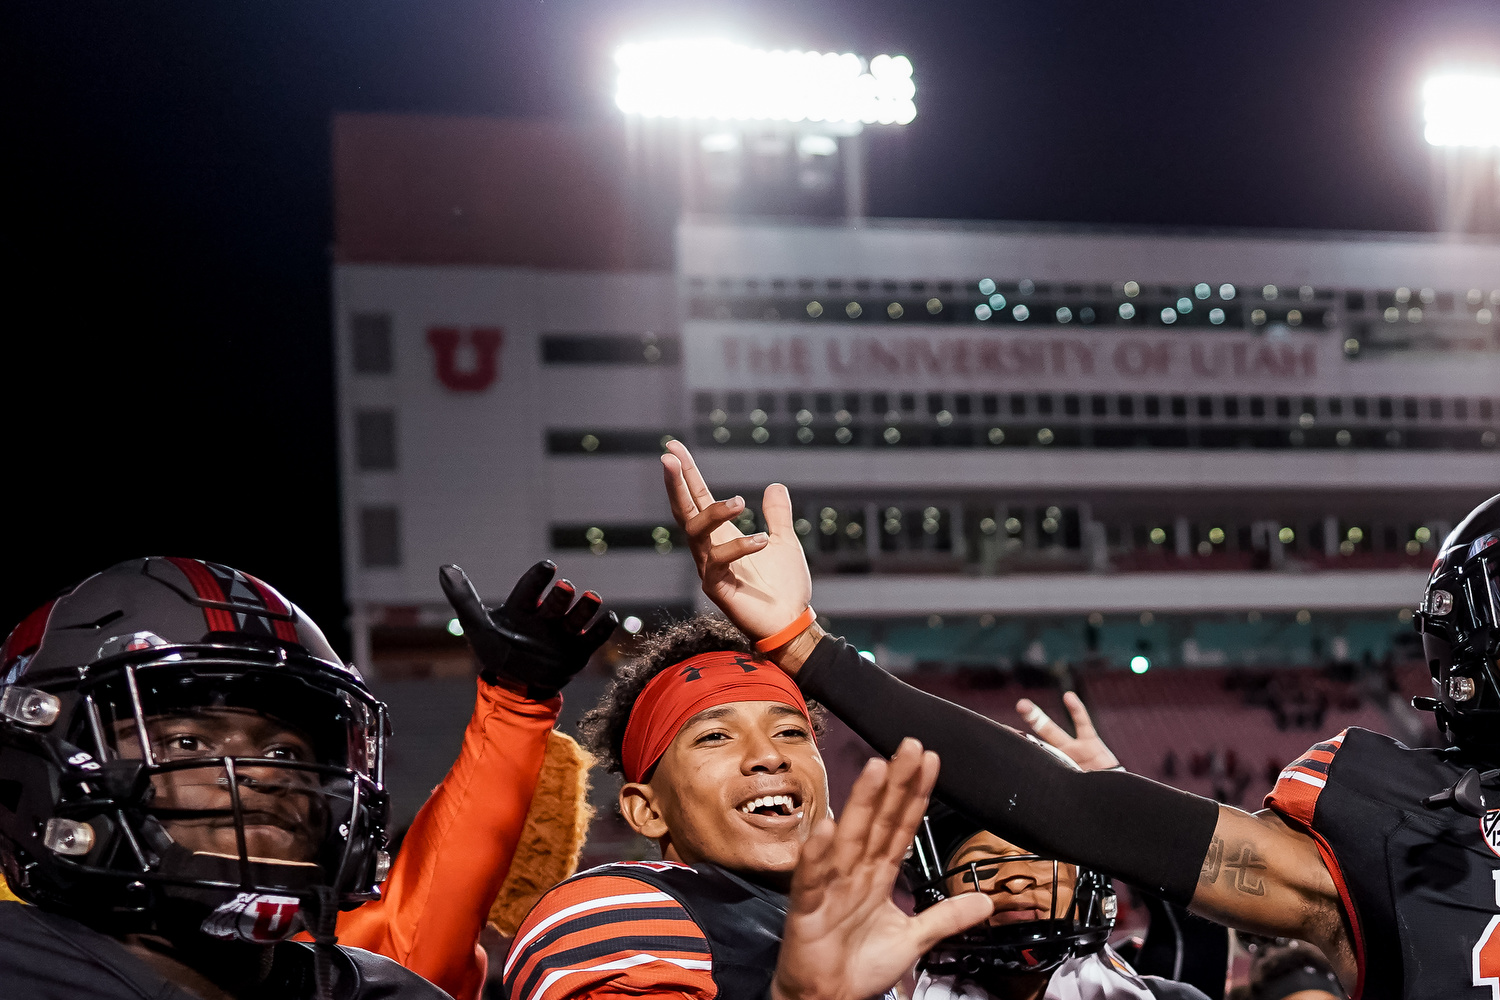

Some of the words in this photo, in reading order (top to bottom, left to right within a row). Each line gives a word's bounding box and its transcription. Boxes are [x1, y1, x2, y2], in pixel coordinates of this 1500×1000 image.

[427, 326, 504, 394] U
[722, 338, 810, 377] THE
[826, 337, 1096, 379] UNIVERSITY
[1112, 339, 1171, 378] OF
[1187, 339, 1317, 380] UTAH
[252, 901, 300, 942] U
